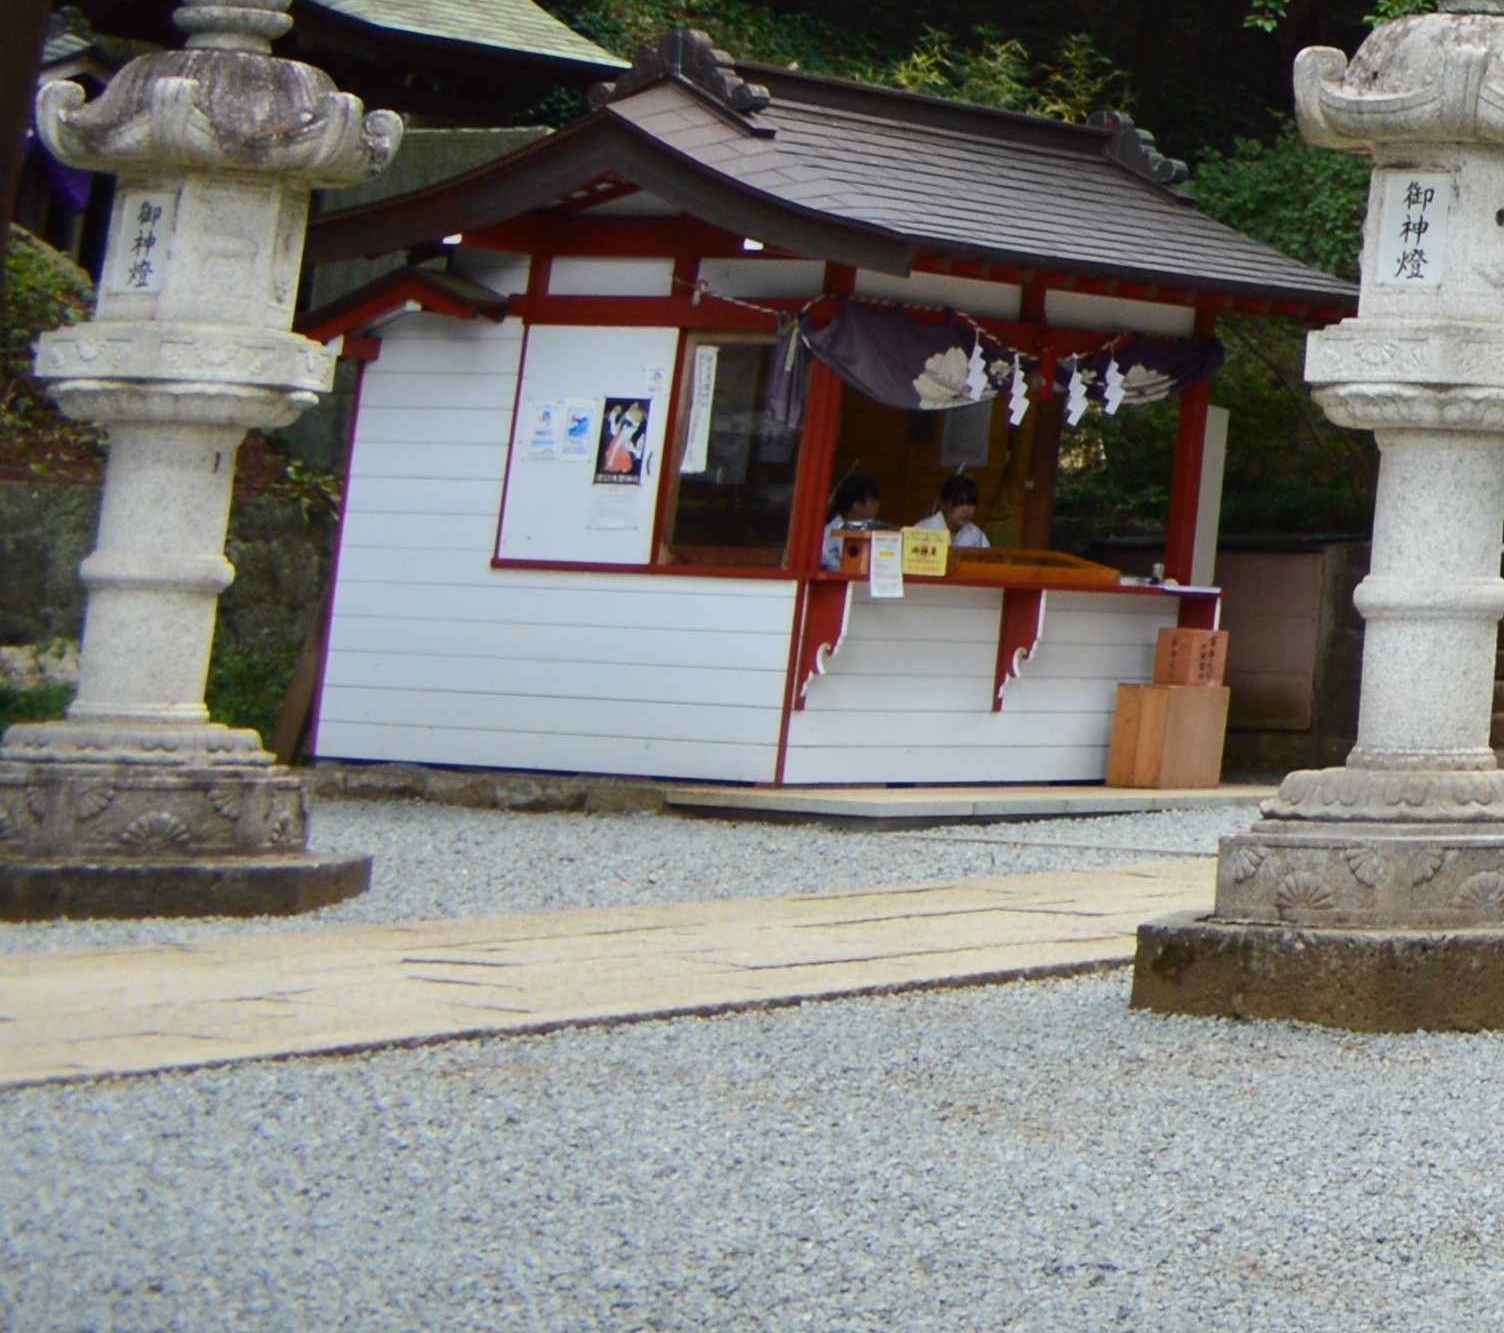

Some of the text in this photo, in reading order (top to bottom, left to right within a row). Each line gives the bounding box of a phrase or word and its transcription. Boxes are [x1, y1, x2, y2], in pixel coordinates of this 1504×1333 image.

[127, 200, 162, 287] 御神燈
[1394, 181, 1435, 280] 御神燈
